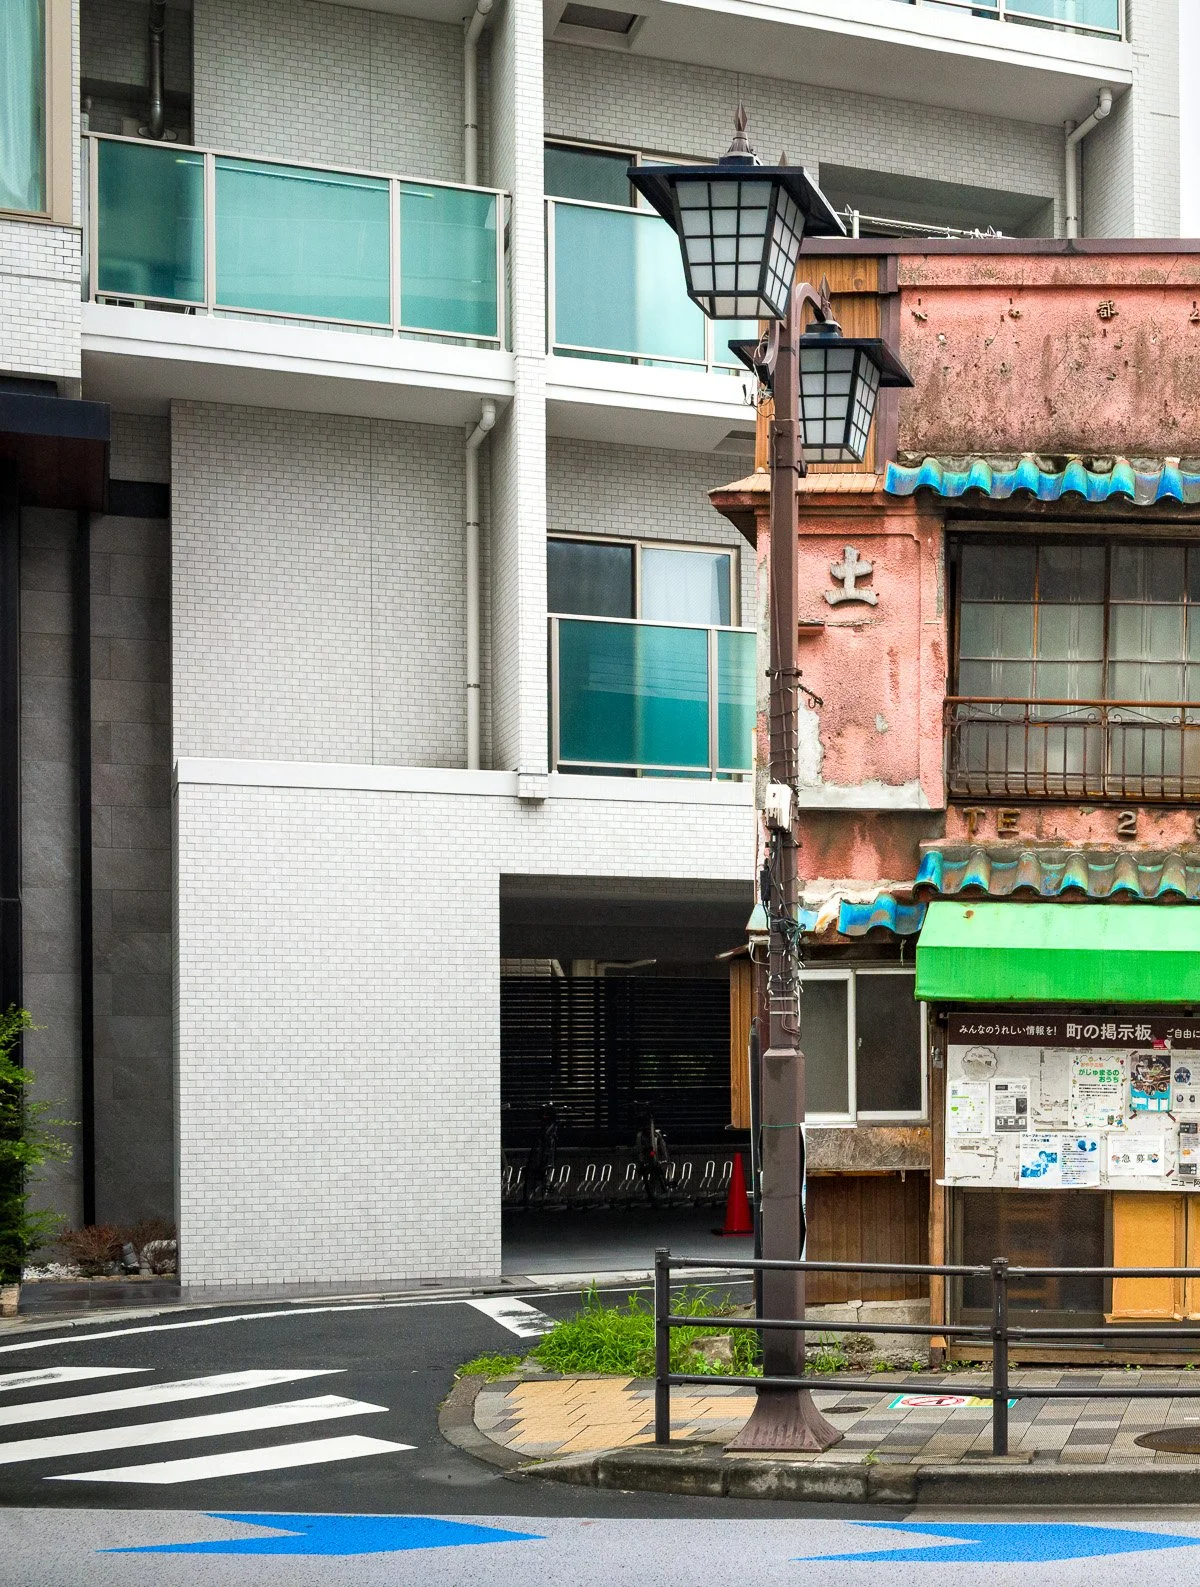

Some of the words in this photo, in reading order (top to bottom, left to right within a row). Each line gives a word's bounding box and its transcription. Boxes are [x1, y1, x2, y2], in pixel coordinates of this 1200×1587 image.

[823, 543, 879, 606] 土
[1066, 1023, 1152, 1040] 町の掲示板
